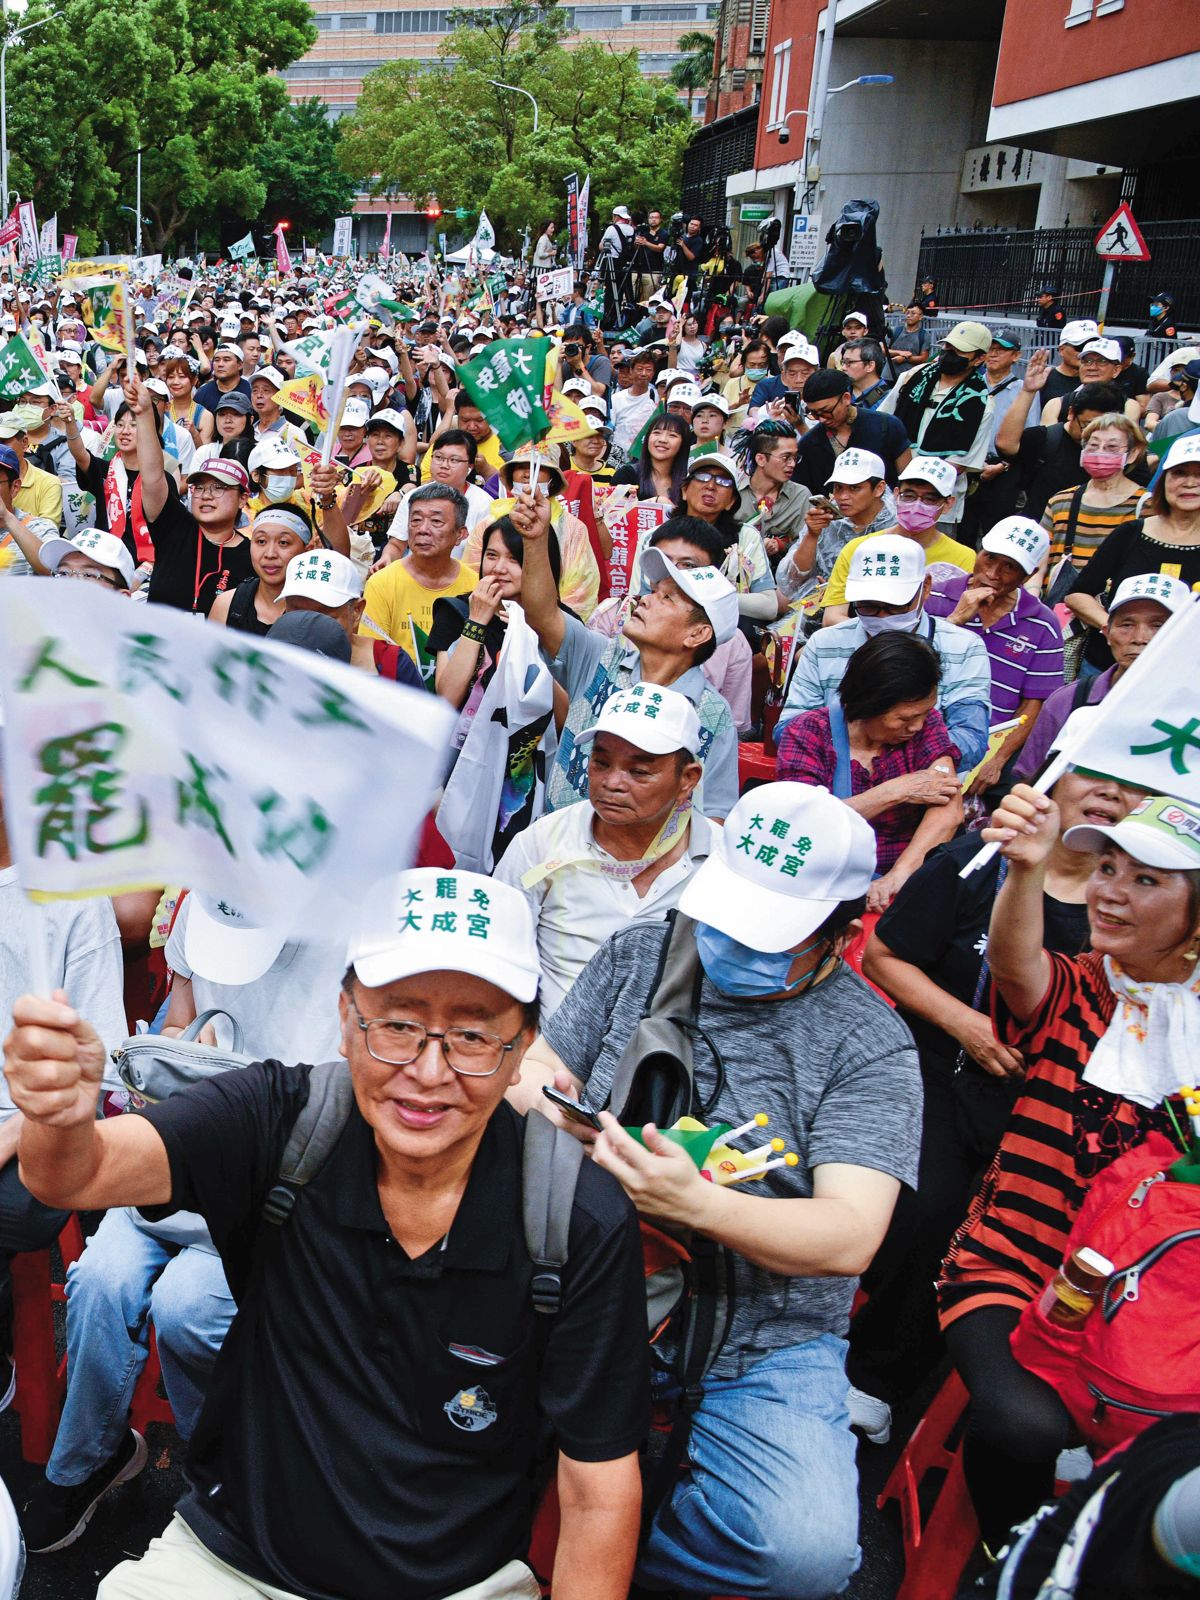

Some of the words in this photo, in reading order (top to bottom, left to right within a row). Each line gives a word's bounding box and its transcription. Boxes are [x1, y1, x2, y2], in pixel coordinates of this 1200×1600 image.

[297, 554, 332, 571] 大罷免
[862, 553, 901, 566] 大罷免
[294, 569, 332, 583] 大成宮
[862, 565, 901, 577] 大成宮
[1133, 576, 1174, 589] 大罷免
[1129, 586, 1172, 599] 大成宮
[617, 686, 664, 705] 大罷免
[608, 701, 661, 720] 大成宮
[749, 812, 813, 859] 大罷免
[735, 833, 805, 878] 大成宮
[402, 876, 491, 911] 大罷免
[397, 910, 491, 941] 大成宮
